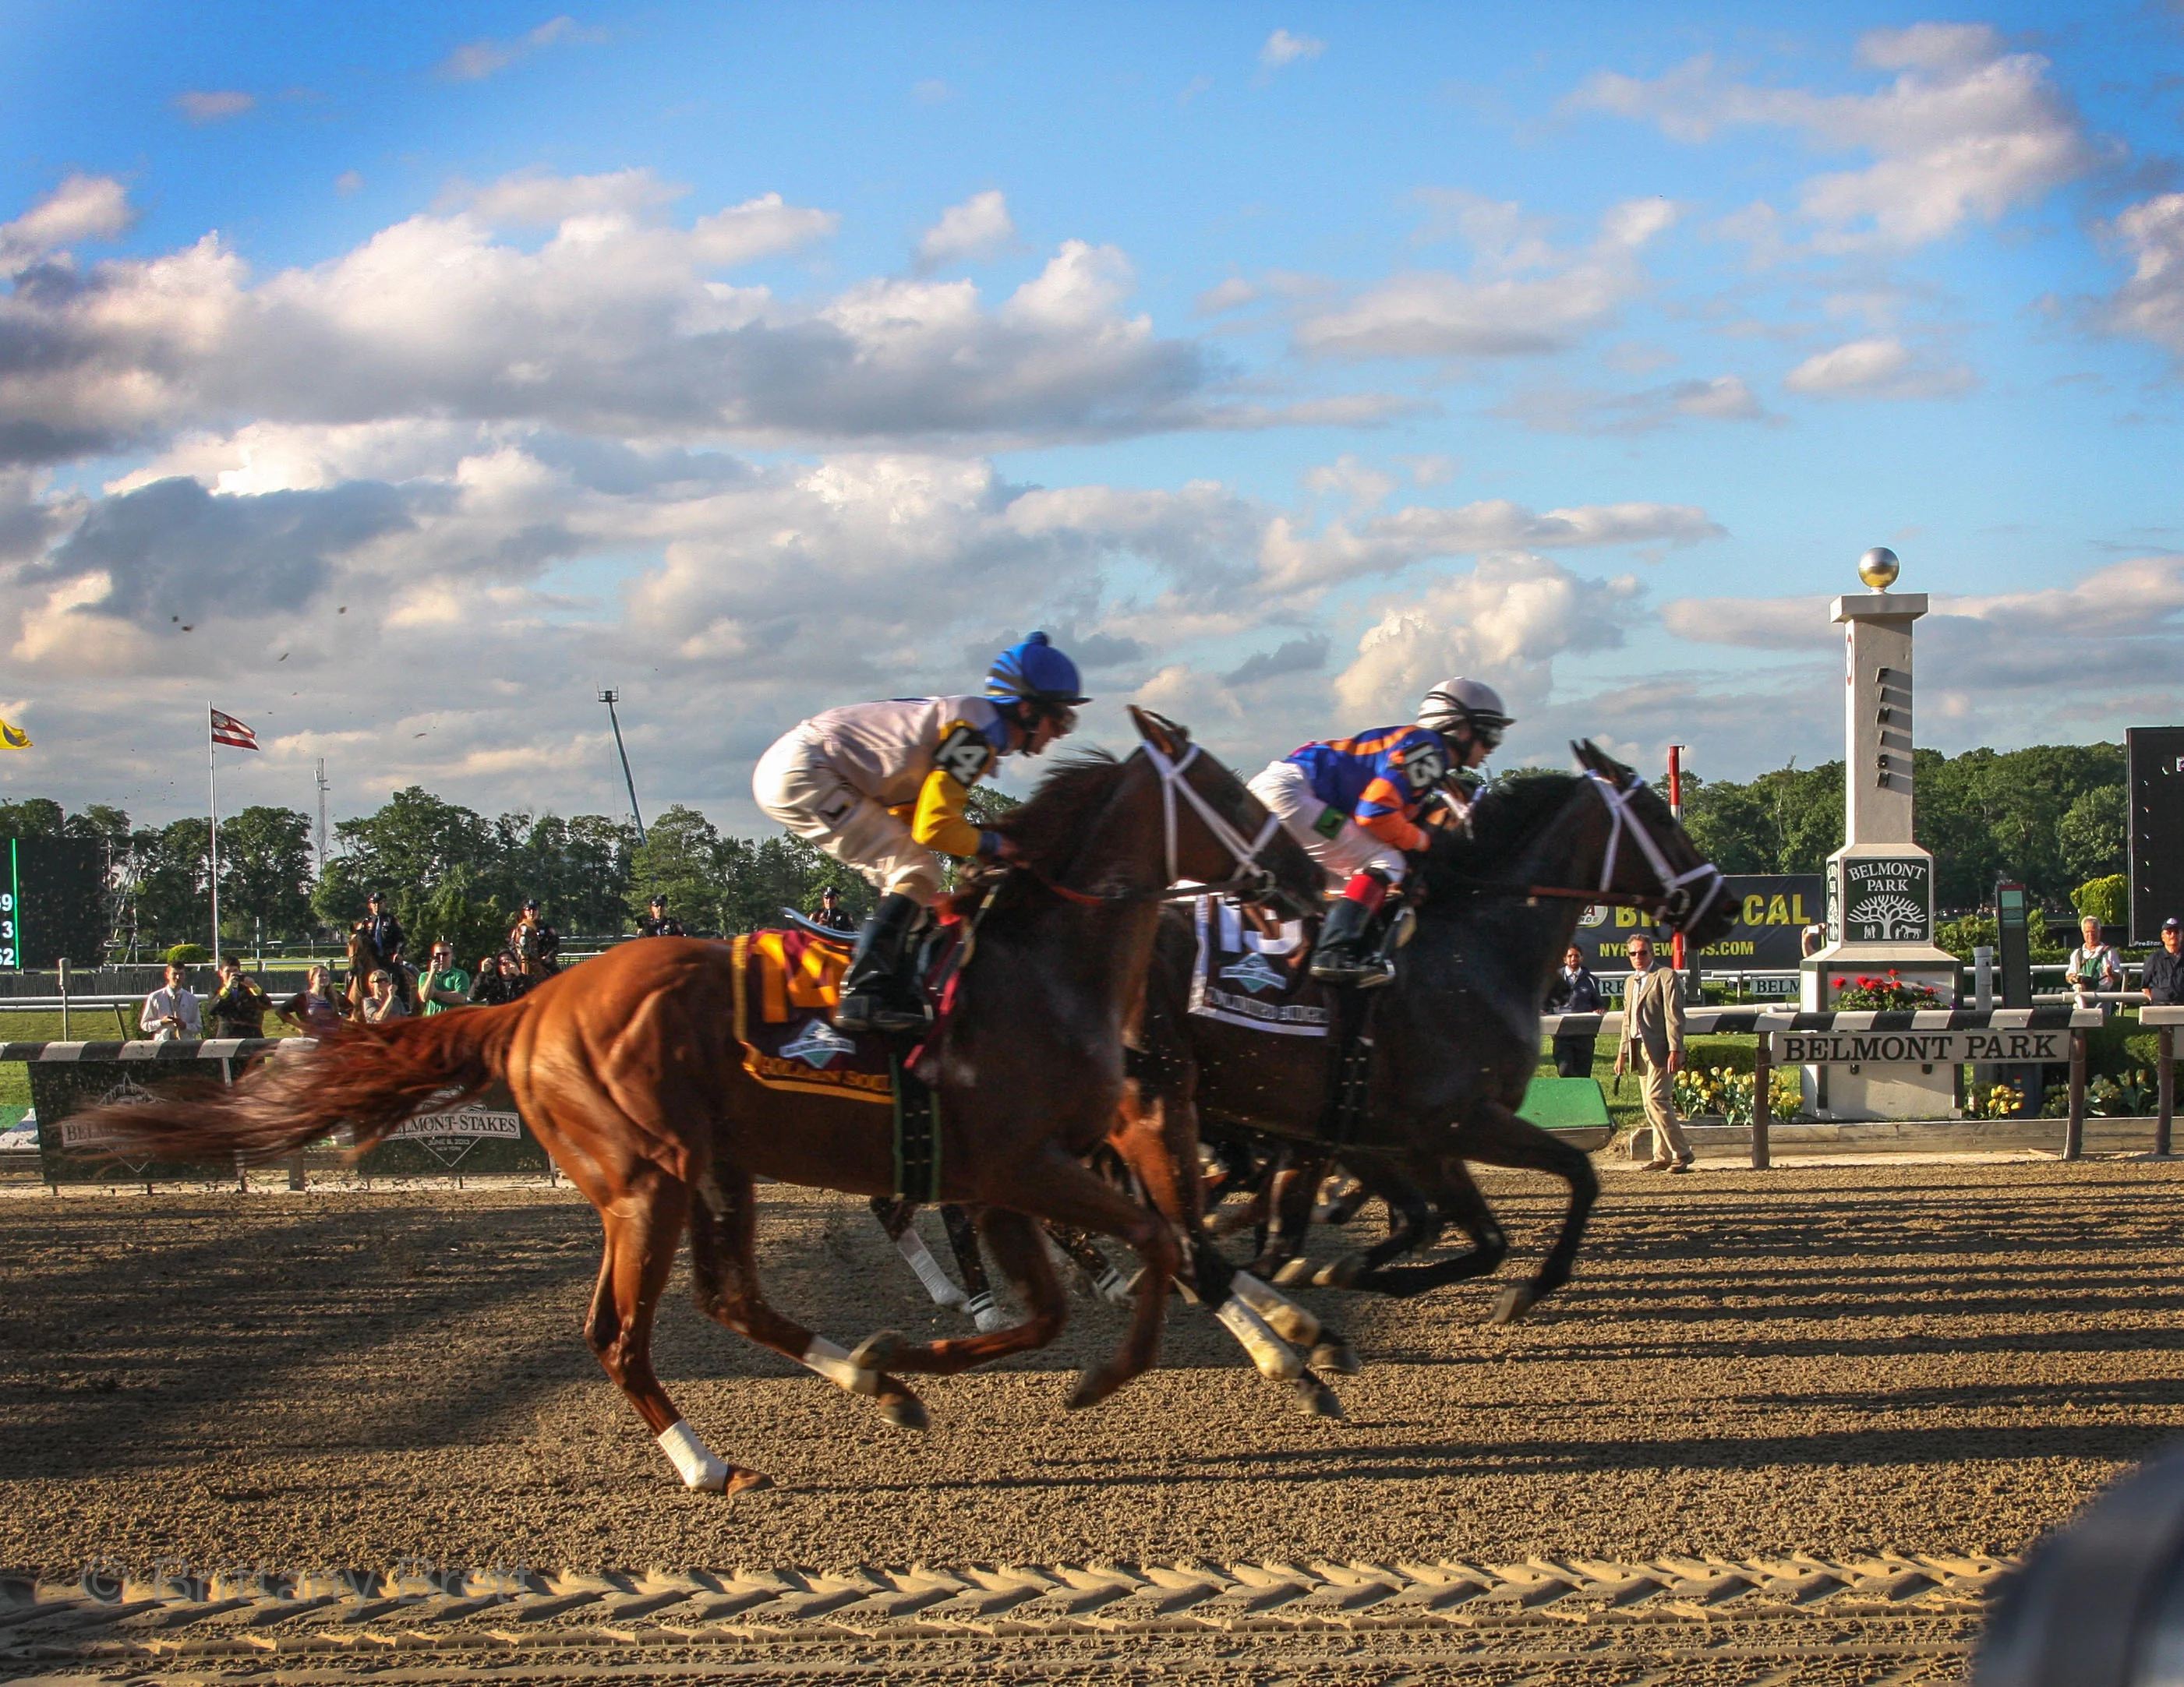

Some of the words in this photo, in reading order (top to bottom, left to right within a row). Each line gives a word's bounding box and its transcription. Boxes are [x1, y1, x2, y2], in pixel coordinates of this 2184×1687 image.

[935, 727, 988, 784] 14
[1847, 863, 1926, 881] BELMONT
[1867, 879, 1909, 891] PARK
[1731, 895, 1811, 926] CAL
[2, 921, 13, 938] 3
[1756, 979, 1800, 994] BELM
[1783, 1036, 1953, 1061] BELMONT
[1964, 1034, 2058, 1060] PARK
